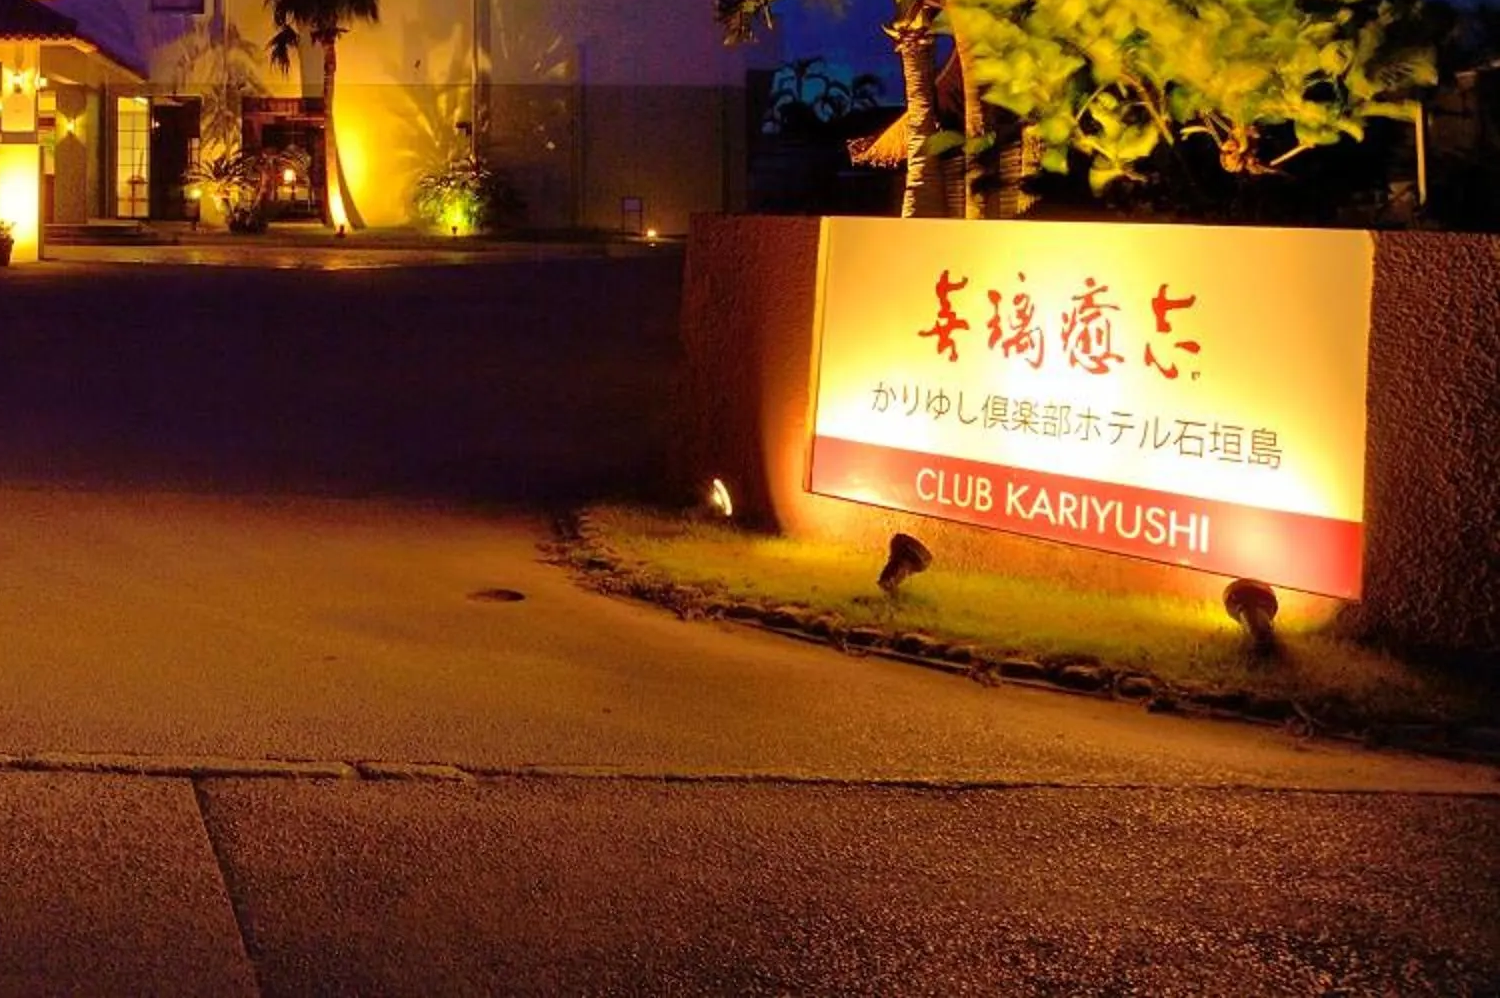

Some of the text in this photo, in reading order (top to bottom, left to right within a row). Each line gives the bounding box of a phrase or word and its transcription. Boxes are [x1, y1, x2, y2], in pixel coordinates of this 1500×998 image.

[871, 381, 1283, 469] かりゆし倶楽部ホテル石垣島
[915, 467, 1210, 553] CLUB KARIYUSHI
